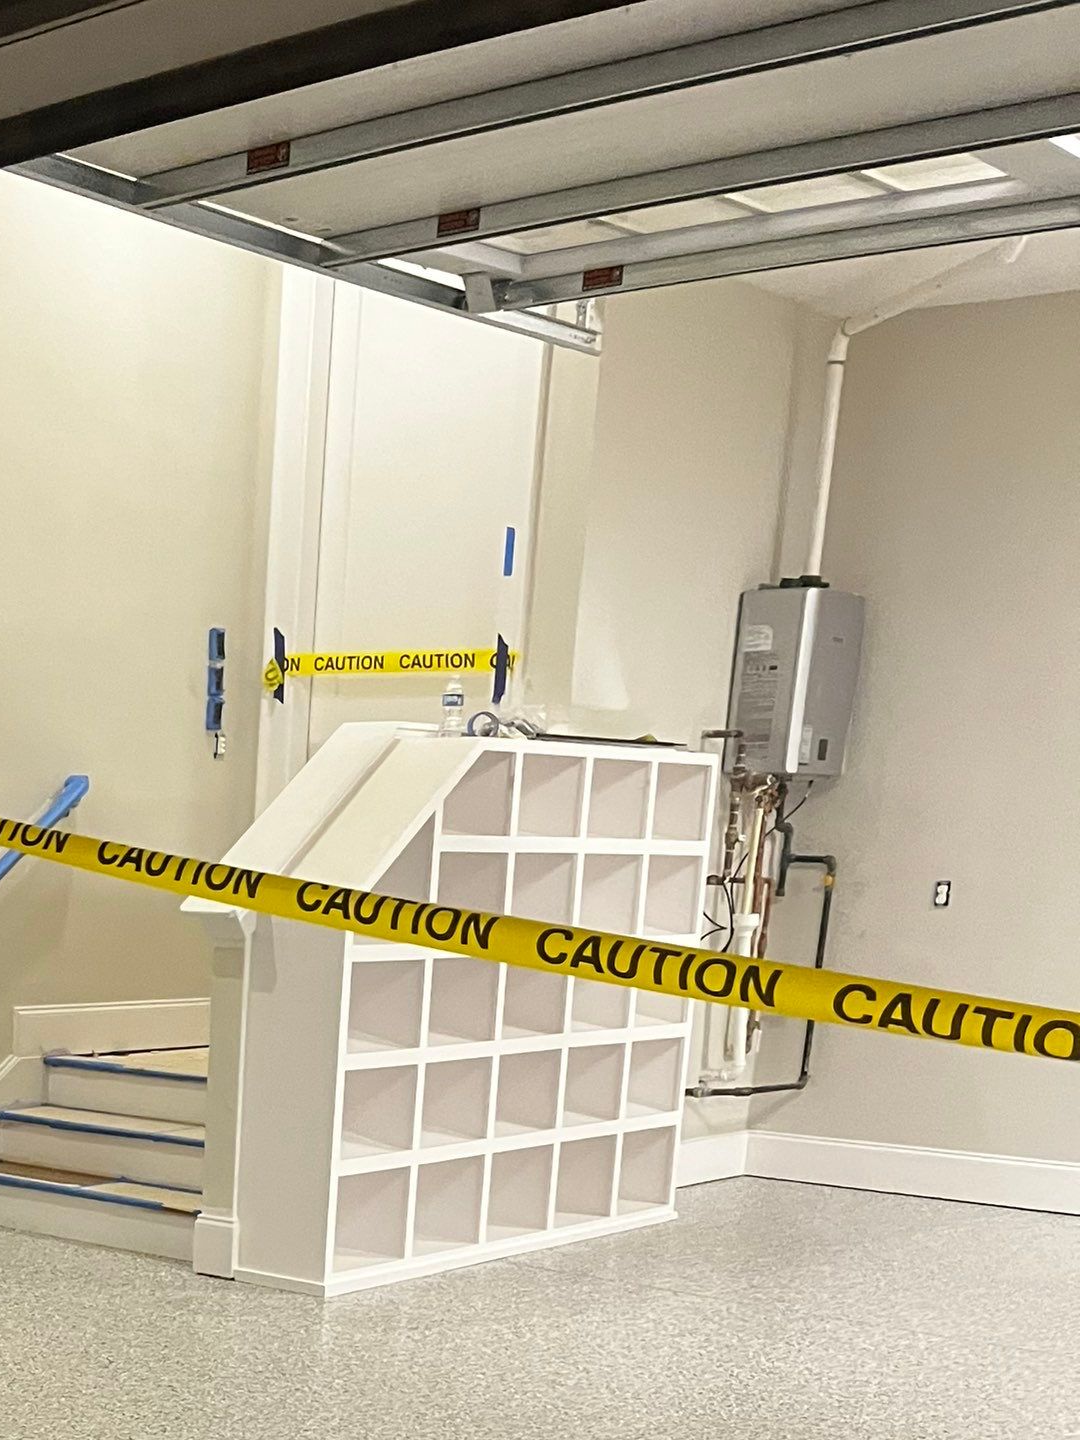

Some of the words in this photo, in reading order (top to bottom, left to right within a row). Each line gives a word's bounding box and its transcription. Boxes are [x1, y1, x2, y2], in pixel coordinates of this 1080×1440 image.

[314, 655, 385, 672] CAUTION
[400, 652, 475, 669] CAUTION
[97, 840, 265, 899] CAUTION
[296, 881, 499, 949] CAUTION
[536, 928, 783, 1007] CAUTION
